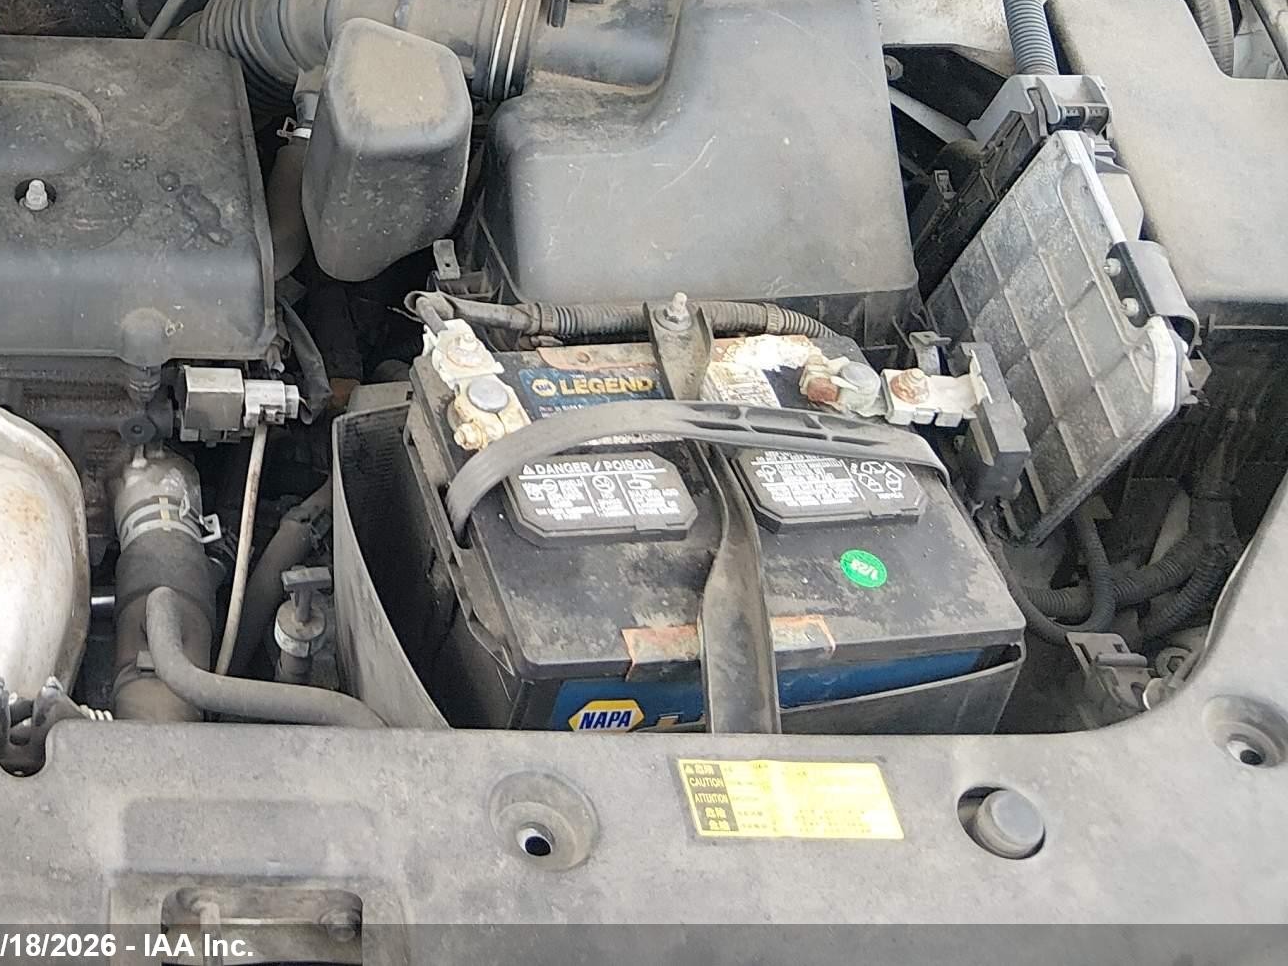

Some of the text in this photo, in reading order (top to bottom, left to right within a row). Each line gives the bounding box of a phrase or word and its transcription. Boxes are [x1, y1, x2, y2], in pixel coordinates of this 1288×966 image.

[558, 377, 654, 396] LEGEND
[533, 460, 593, 475] DANGER
[601, 458, 655, 472] POISON
[578, 710, 633, 730] NAPA
[688, 777, 725, 788] CAUTION
[694, 793, 730, 804] ATTENTION
